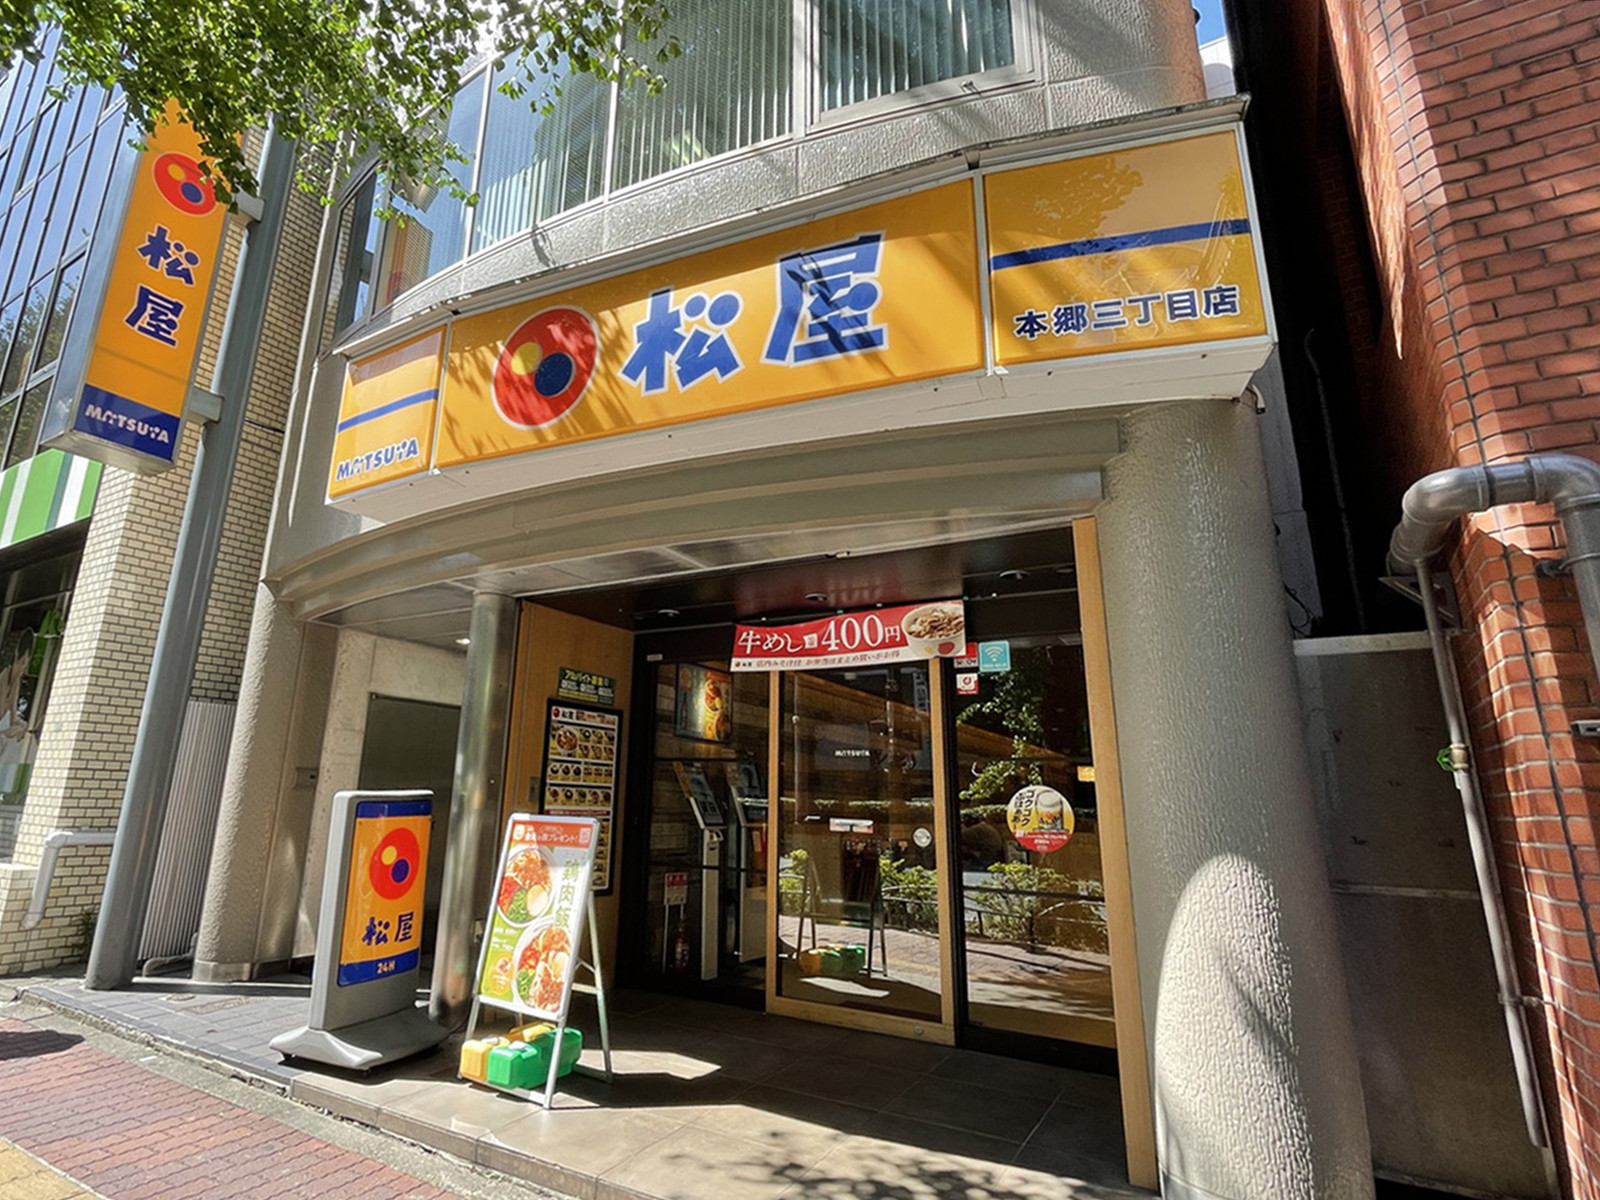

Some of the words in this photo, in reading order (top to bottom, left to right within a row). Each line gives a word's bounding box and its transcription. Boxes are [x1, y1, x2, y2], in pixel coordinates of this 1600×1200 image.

[124, 223, 201, 348] 松屋
[618, 230, 887, 396] 松屋
[1012, 284, 1240, 340] 本郷三丁目店
[85, 404, 169, 444] MATSUYA
[335, 436, 420, 481] MATSUYA
[738, 629, 803, 655] 牛めし
[821, 614, 900, 652] 400円
[362, 911, 414, 946] 松屋
[377, 960, 396, 974] 24H
